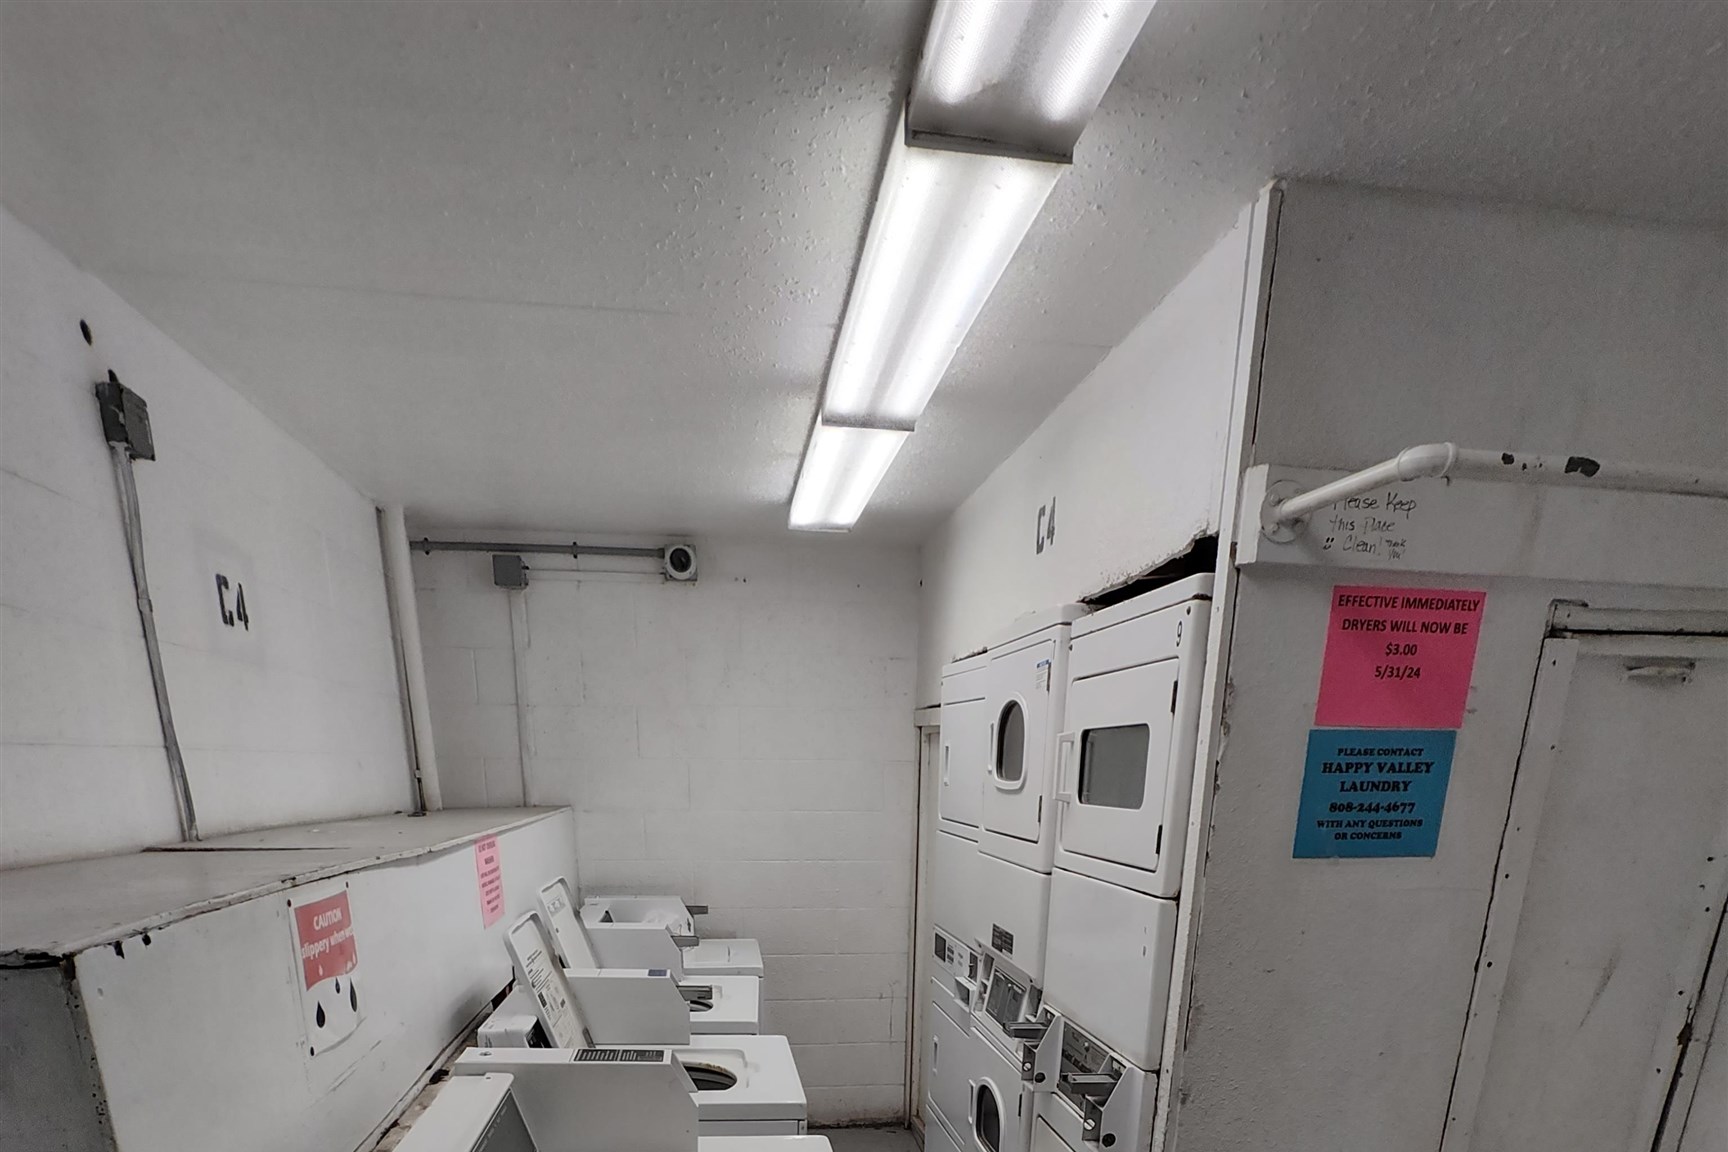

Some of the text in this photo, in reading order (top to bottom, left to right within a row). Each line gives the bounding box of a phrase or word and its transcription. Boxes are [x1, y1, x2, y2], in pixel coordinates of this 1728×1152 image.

[1036, 496, 1056, 555] C4
[215, 573, 249, 632] C4
[1338, 594, 1480, 612] EFFECTIVE IMMEDIATELY
[1176, 620, 1183, 648] 9
[1342, 618, 1469, 635] DRYERS WILL NOW BE
[1385, 641, 1418, 657] $3.00
[1374, 665, 1421, 681] 5/31/24
[1337, 748, 1424, 756] PLEASE CONTACT
[1321, 761, 1434, 774] HAPPY VALLEY
[1339, 780, 1412, 793] LAUNDRY
[1329, 802, 1416, 814] 808-244-4677
[1316, 819, 1424, 829] WITH ANY QUESTIONS
[1334, 831, 1402, 840] OR CONCERNS
[313, 907, 343, 931] CAUTION
[301, 937, 329, 960] slippery
